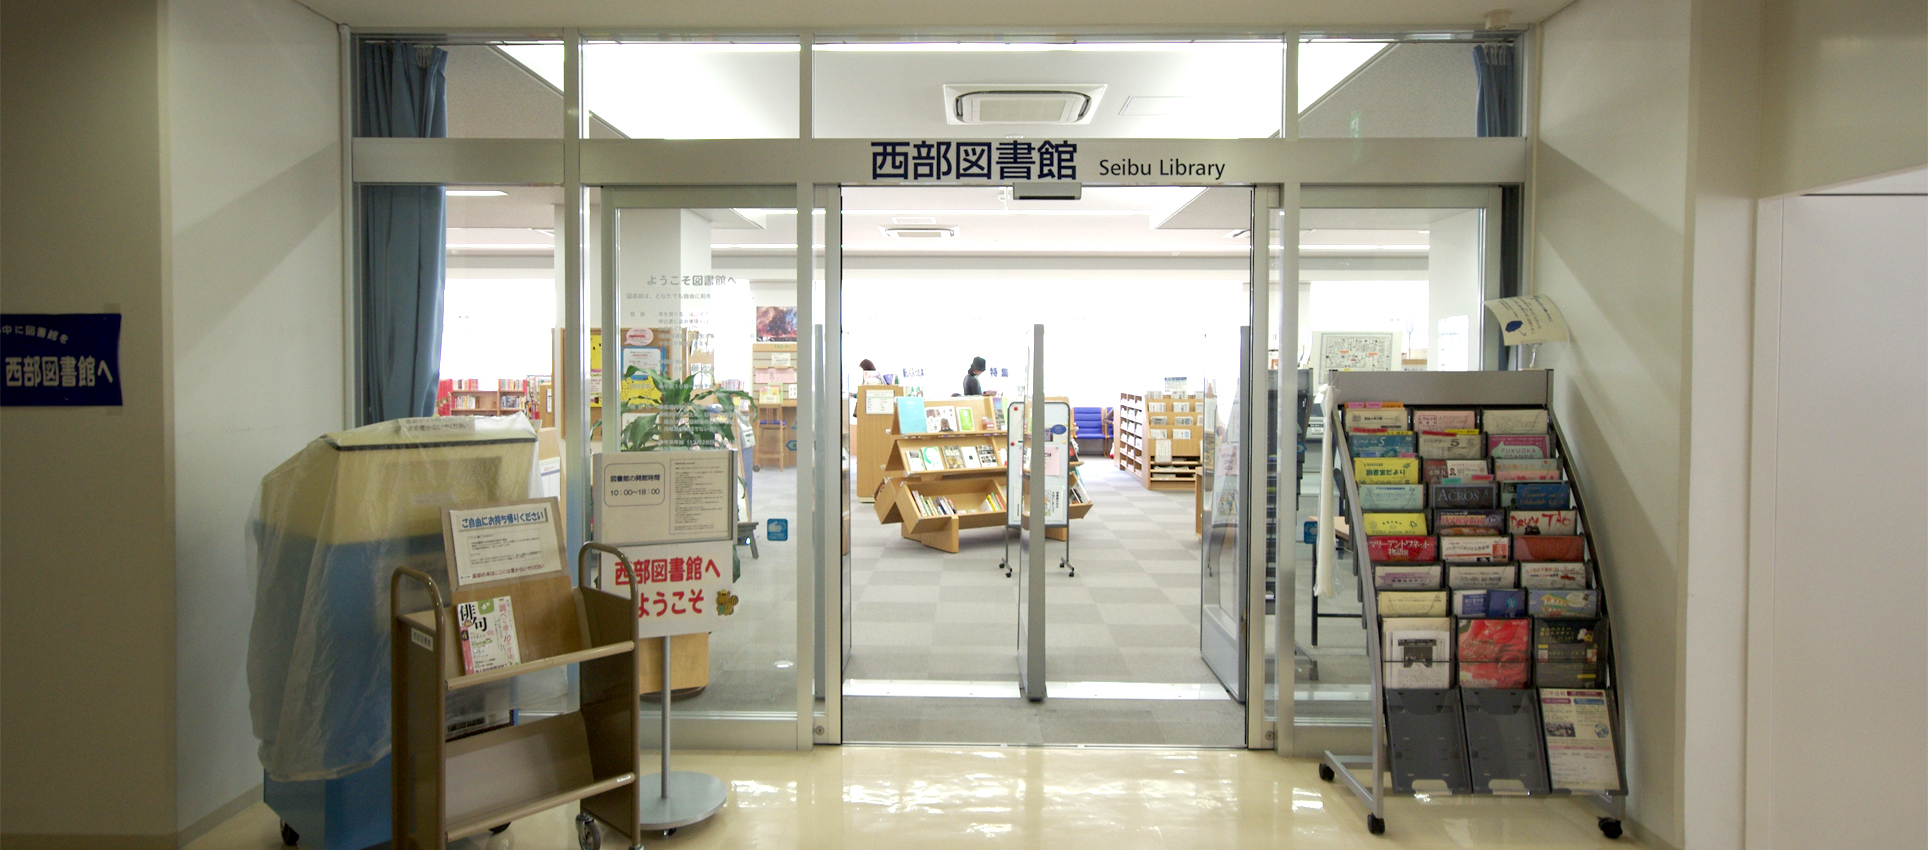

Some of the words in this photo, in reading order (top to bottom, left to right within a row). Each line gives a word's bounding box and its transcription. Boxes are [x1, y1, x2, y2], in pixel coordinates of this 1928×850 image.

[871, 140, 1077, 181] 西部図書館
[1099, 159, 1152, 177] Seibu
[1159, 159, 1226, 180] Library
[646, 274, 737, 287] ようこそ図書館へ
[0, 325, 69, 345] 中に図書館を
[4, 355, 114, 388] 西部図書館へ
[610, 475, 661, 483] 図書館の開館時間
[1437, 488, 1480, 502] ACROS
[461, 511, 545, 530] ご自由にお持ち帰りください
[614, 555, 721, 587] 西部図書館へ
[638, 588, 705, 619] ようこそ
[459, 603, 488, 633] 俳句
